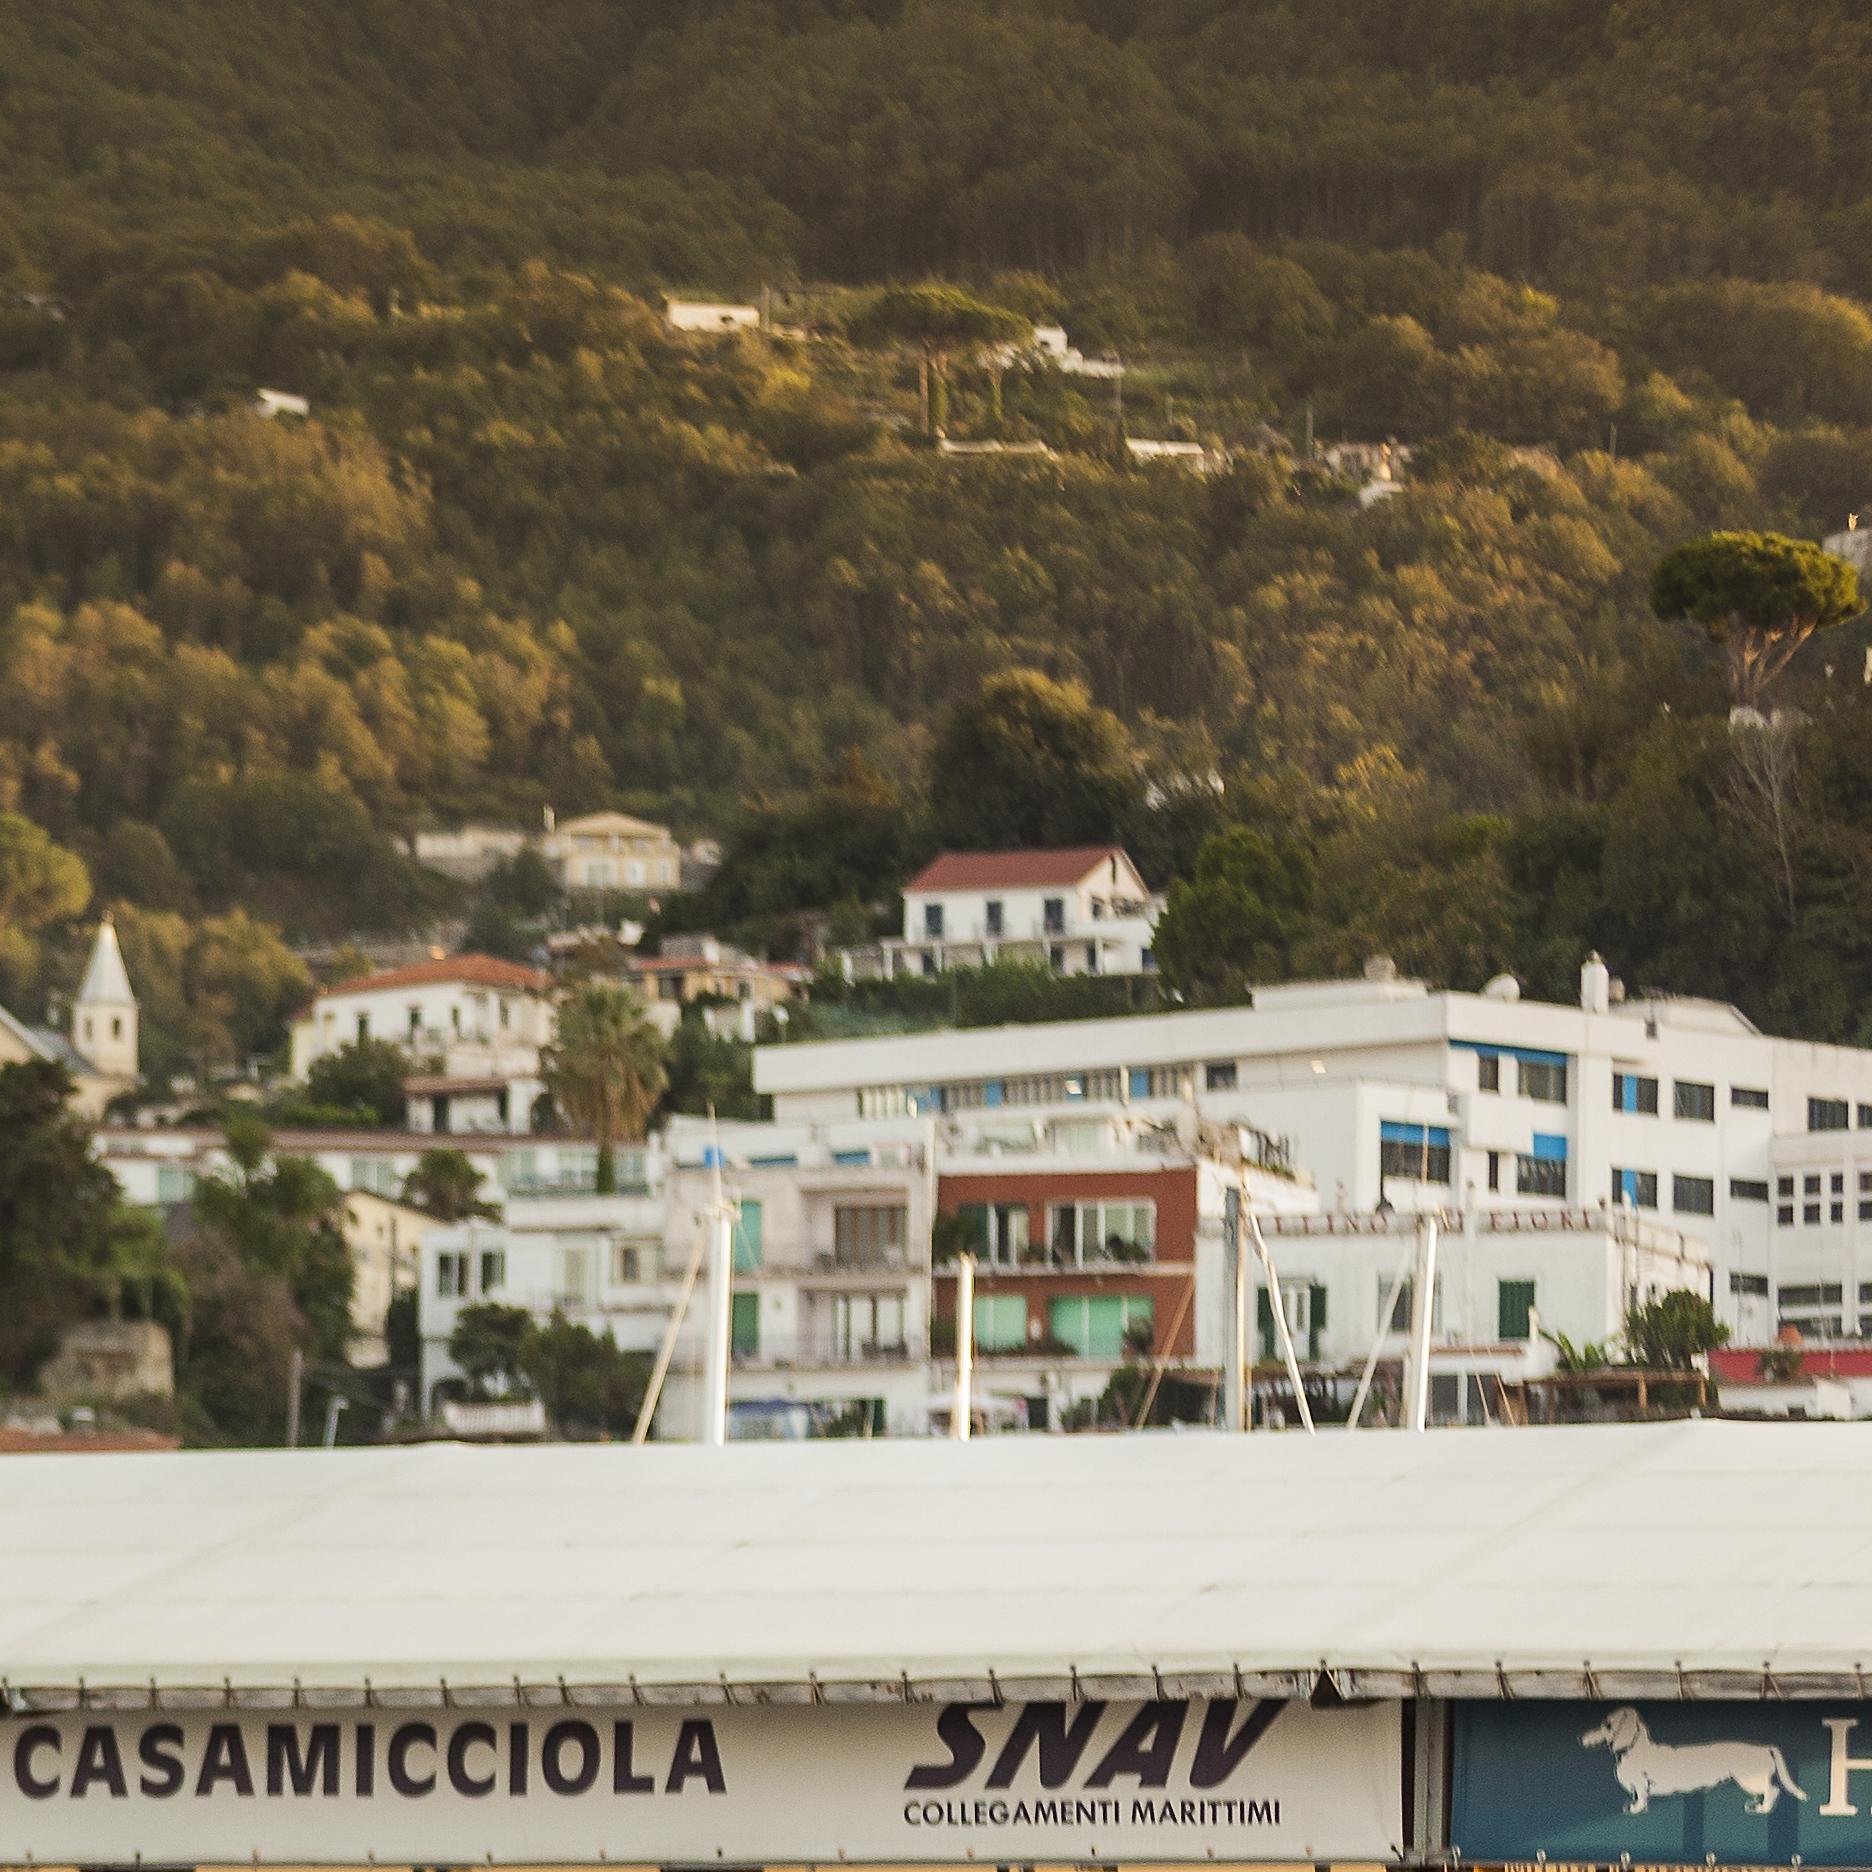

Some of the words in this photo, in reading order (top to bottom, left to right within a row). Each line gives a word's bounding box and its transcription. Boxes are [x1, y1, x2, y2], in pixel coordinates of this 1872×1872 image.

[12, 1719, 729, 1798] CASAMICCIOLA
[904, 1699, 1292, 1791] SNAV
[903, 1799, 1120, 1827] COLLEGAMENTI
[1131, 1798, 1281, 1826] MARITTIMI
